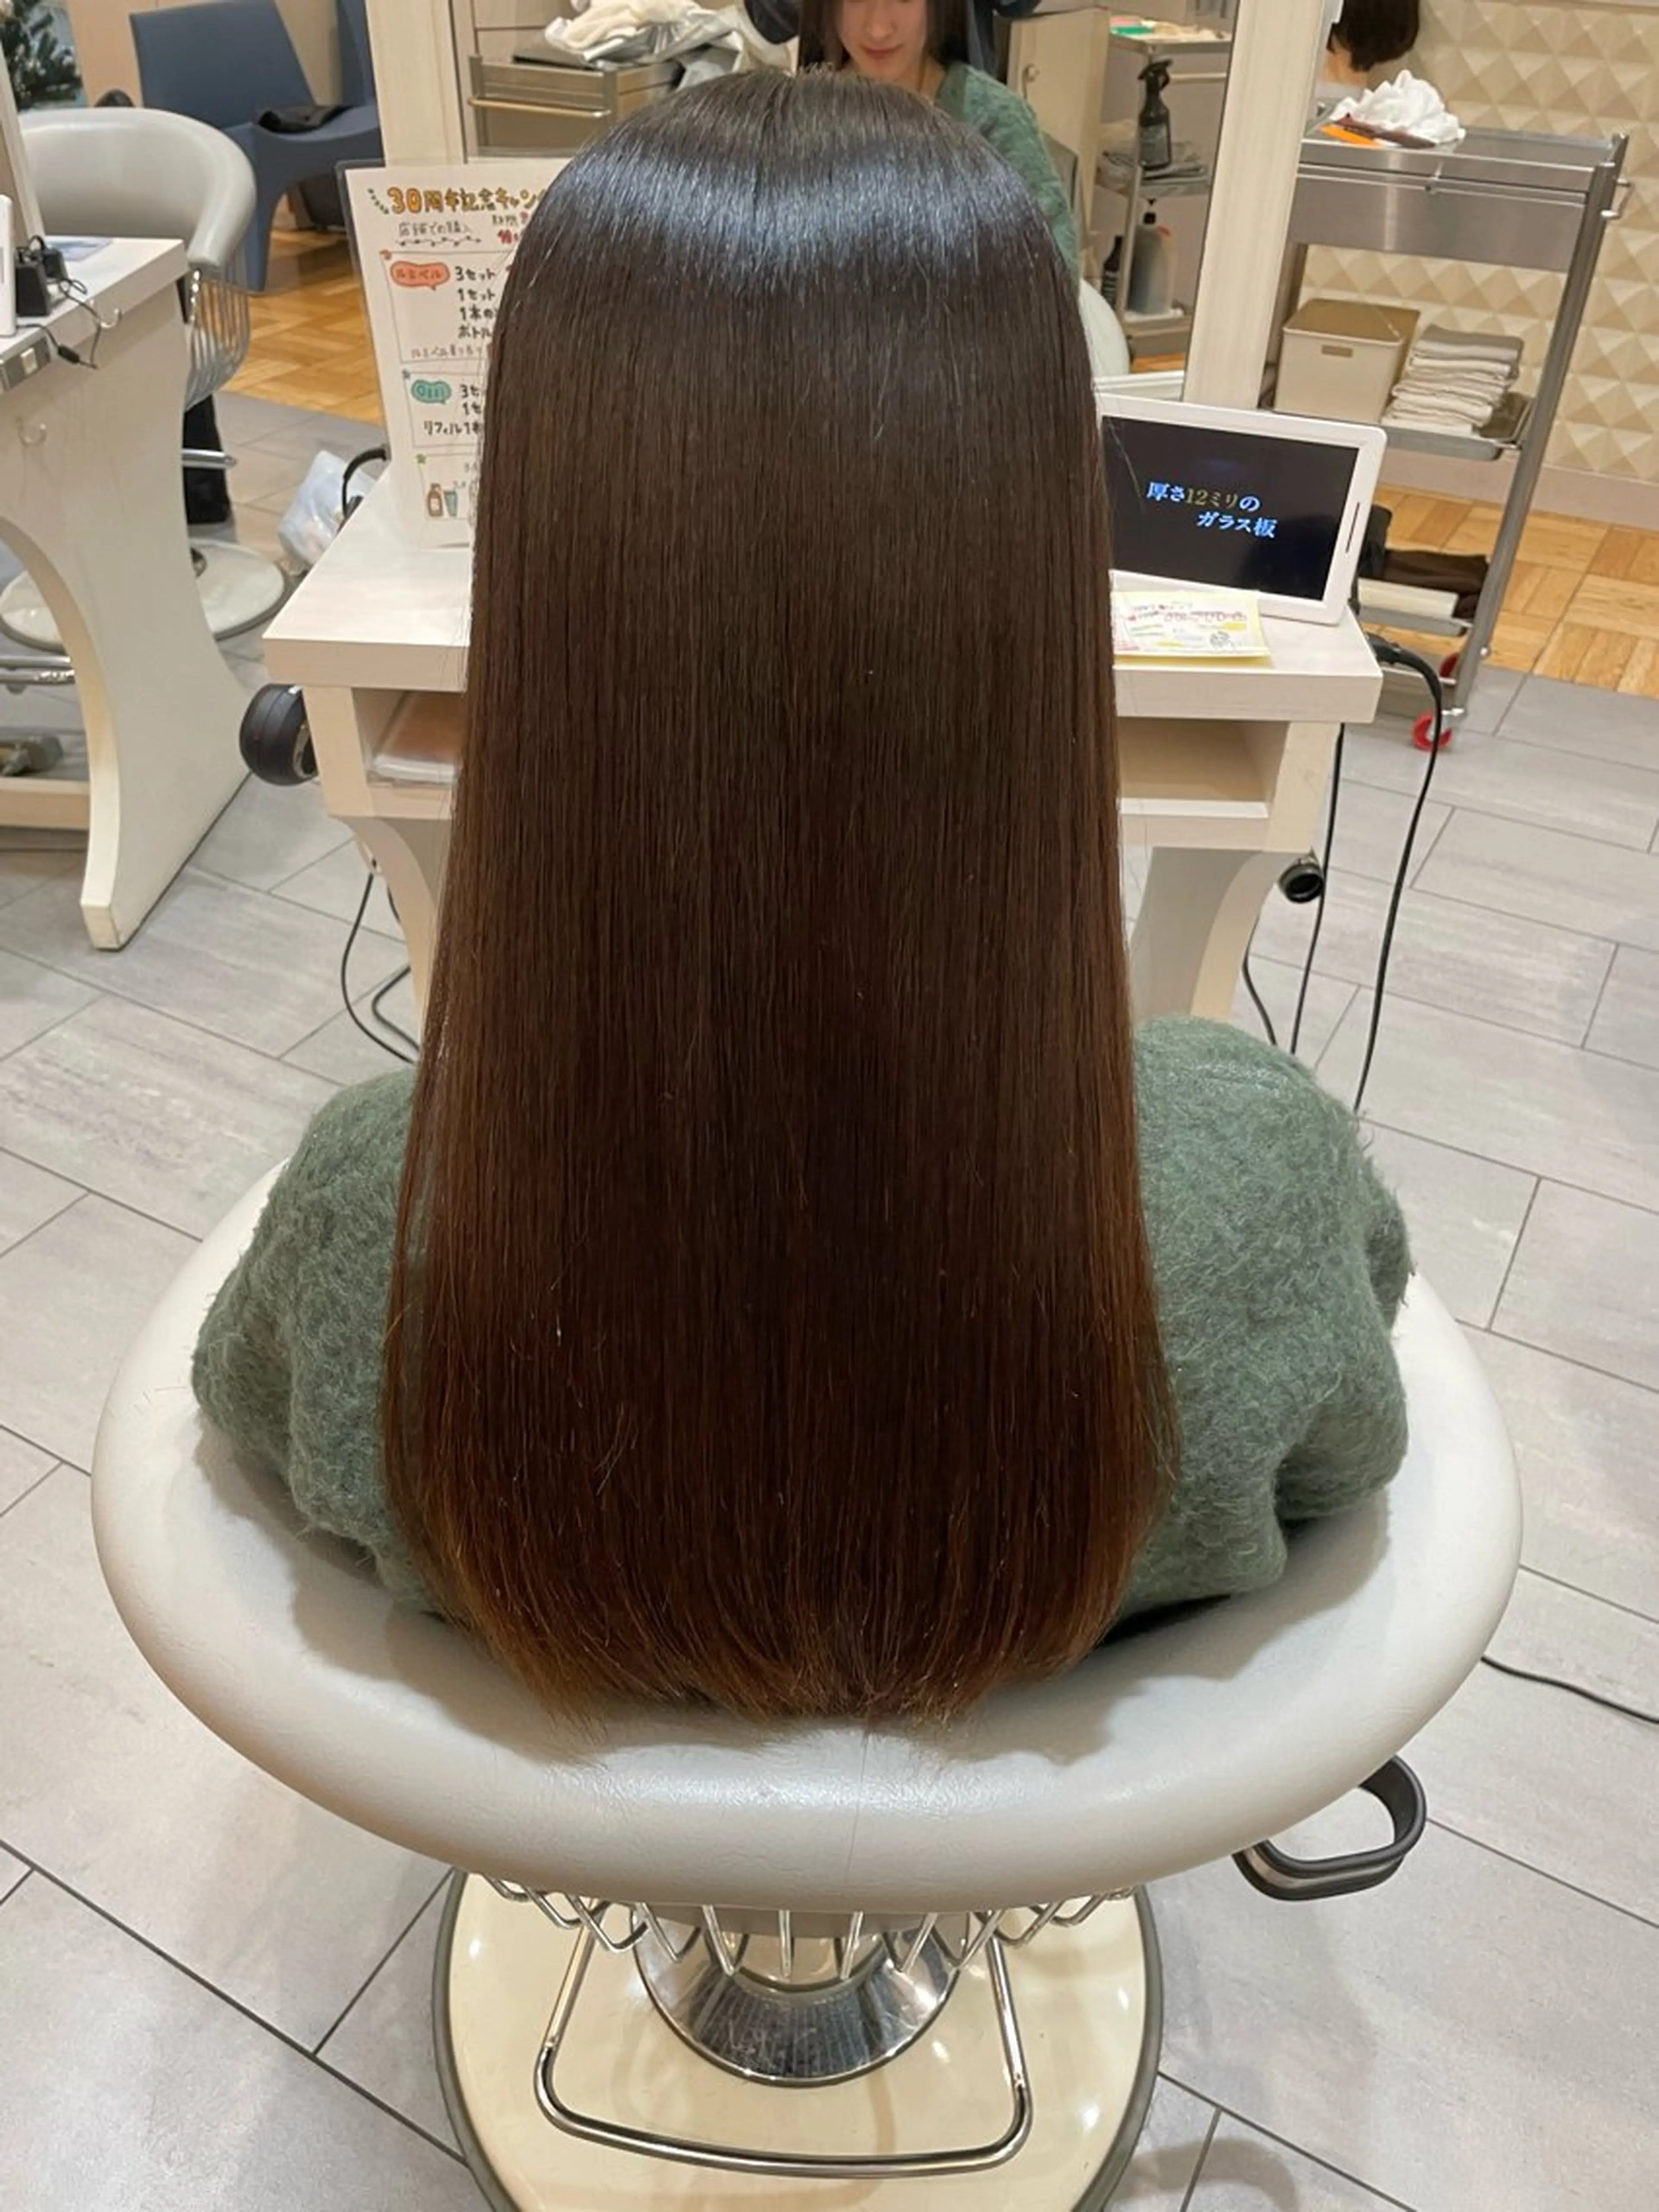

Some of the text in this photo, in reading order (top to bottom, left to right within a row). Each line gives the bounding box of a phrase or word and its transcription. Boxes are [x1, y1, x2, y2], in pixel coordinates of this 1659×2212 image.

[387, 186, 545, 214] 30周年記念キャン
[1146, 481, 1262, 512] 厚さ12ミリの
[1196, 511, 1278, 538] ガラス板
